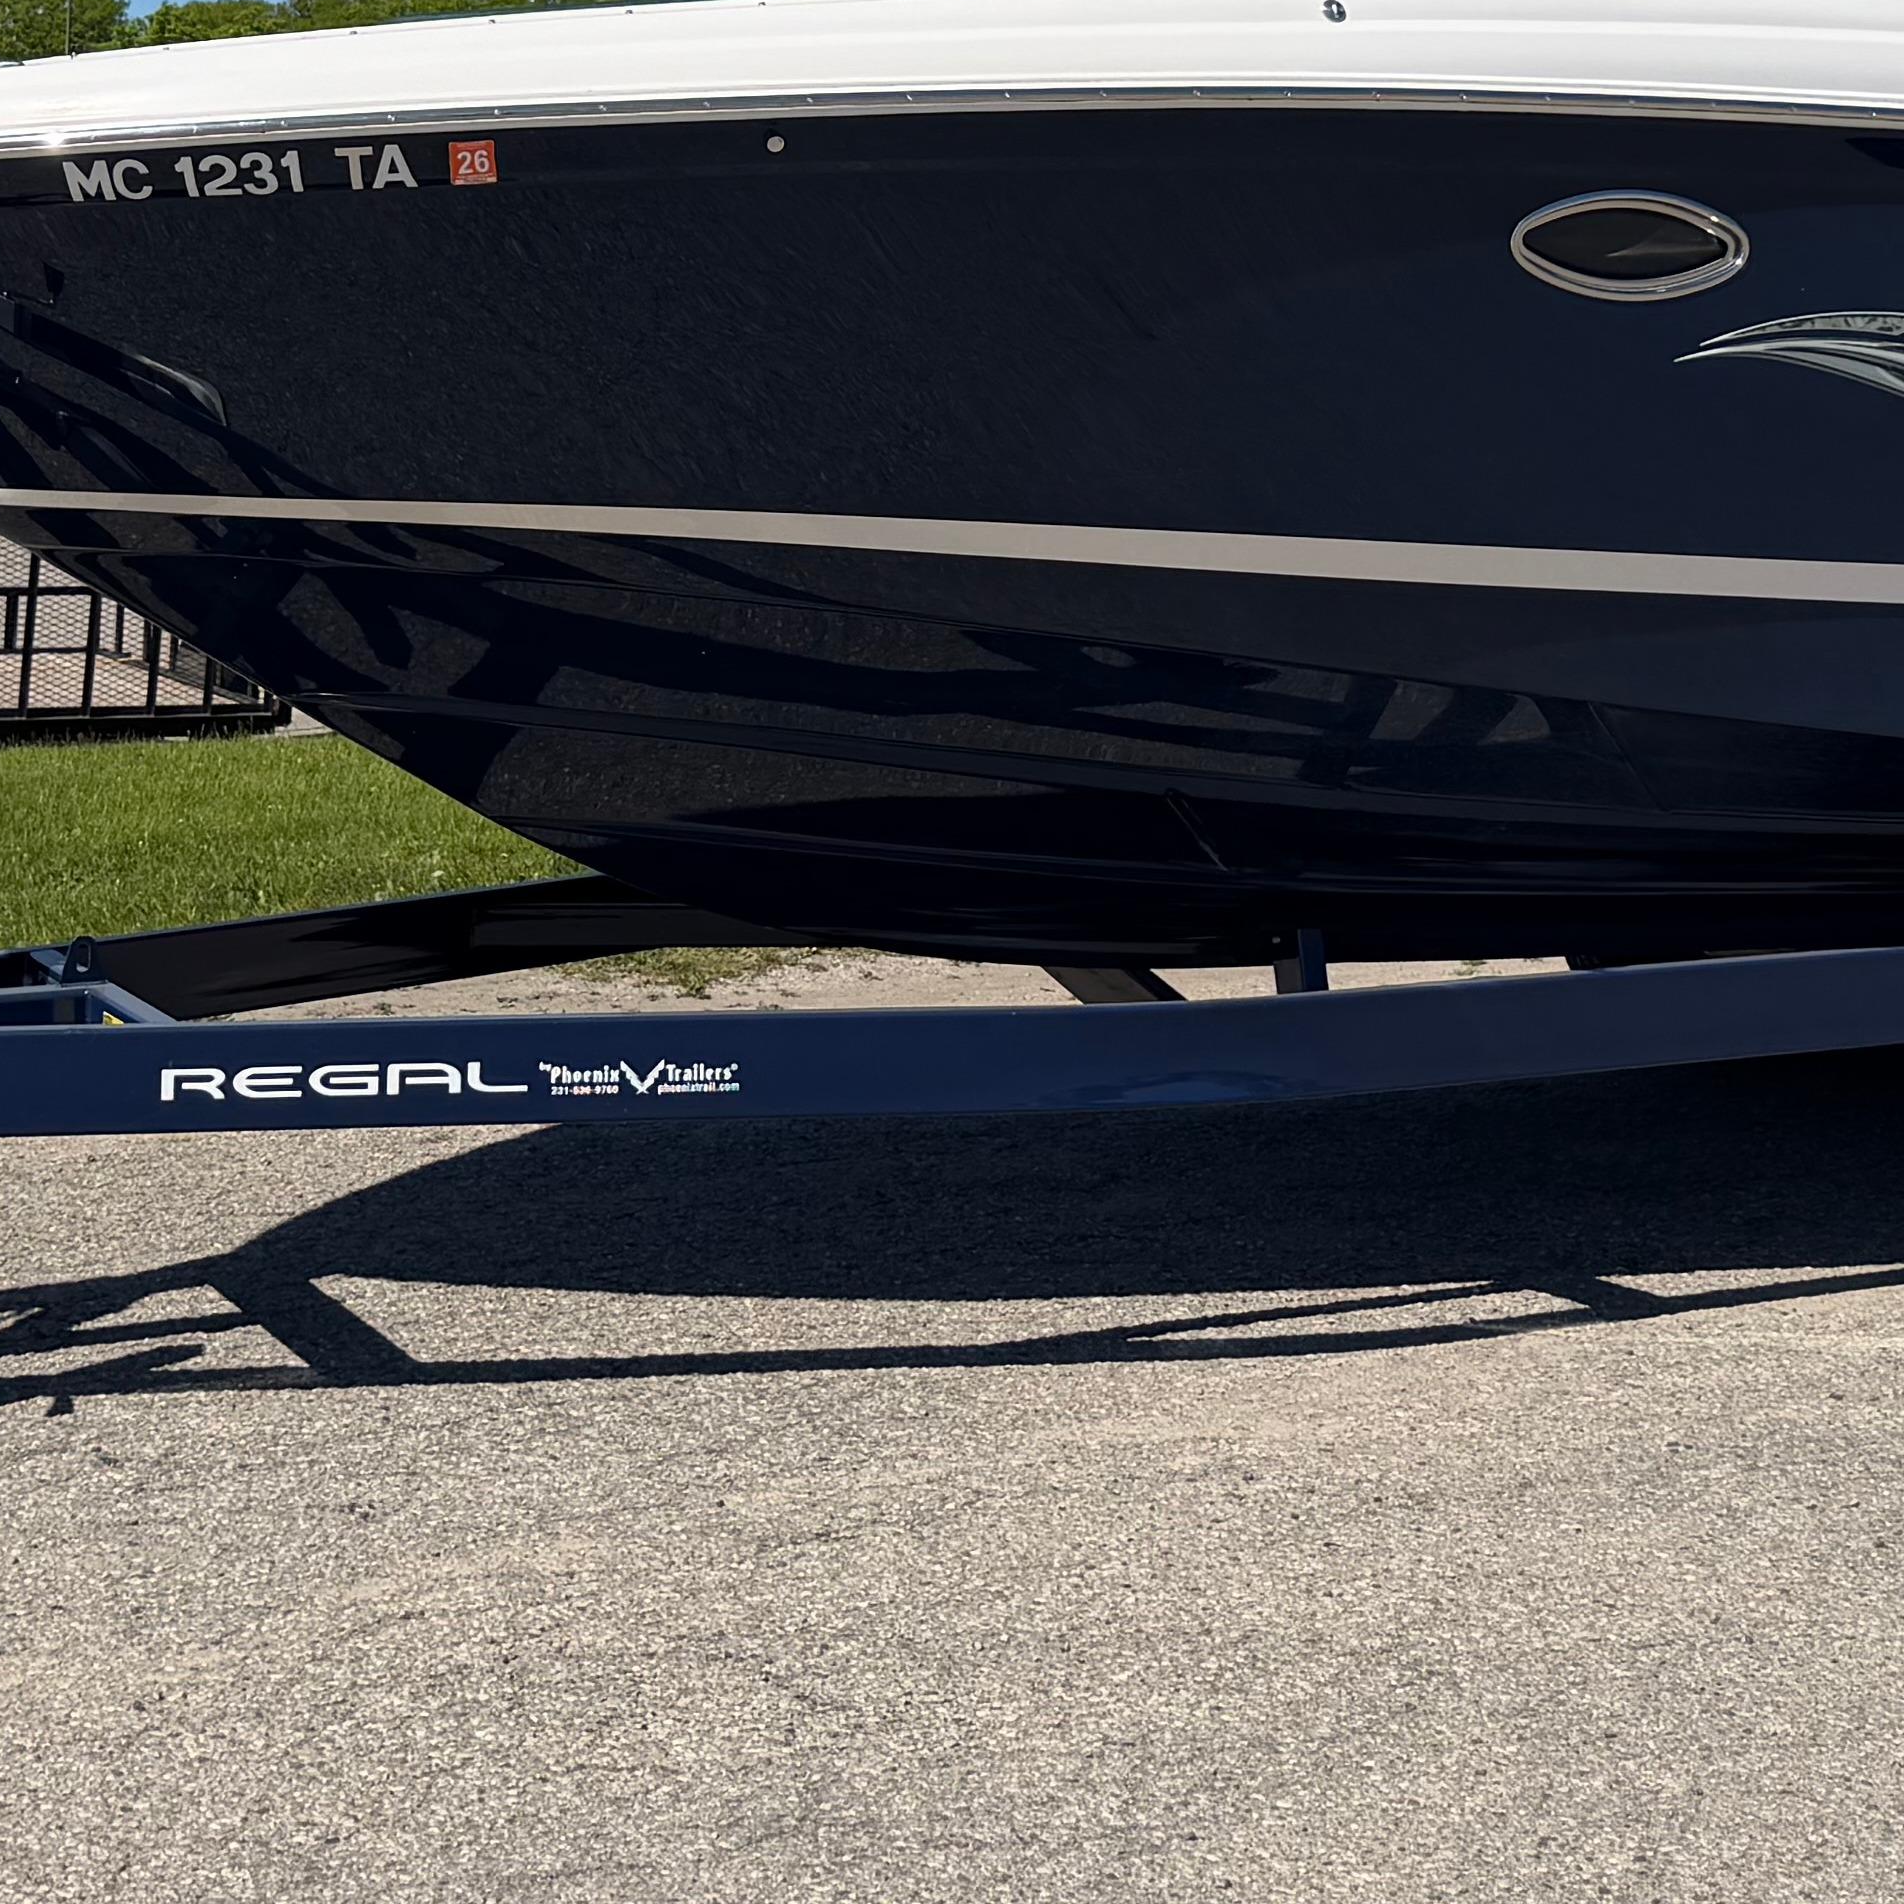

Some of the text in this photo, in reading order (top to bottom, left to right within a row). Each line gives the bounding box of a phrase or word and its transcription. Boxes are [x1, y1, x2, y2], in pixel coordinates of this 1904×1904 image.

[62, 144, 418, 202] MC 1231 TA
[457, 149, 489, 174] 26
[161, 1062, 528, 1100] REGAL
[550, 1064, 620, 1084] Phoenix
